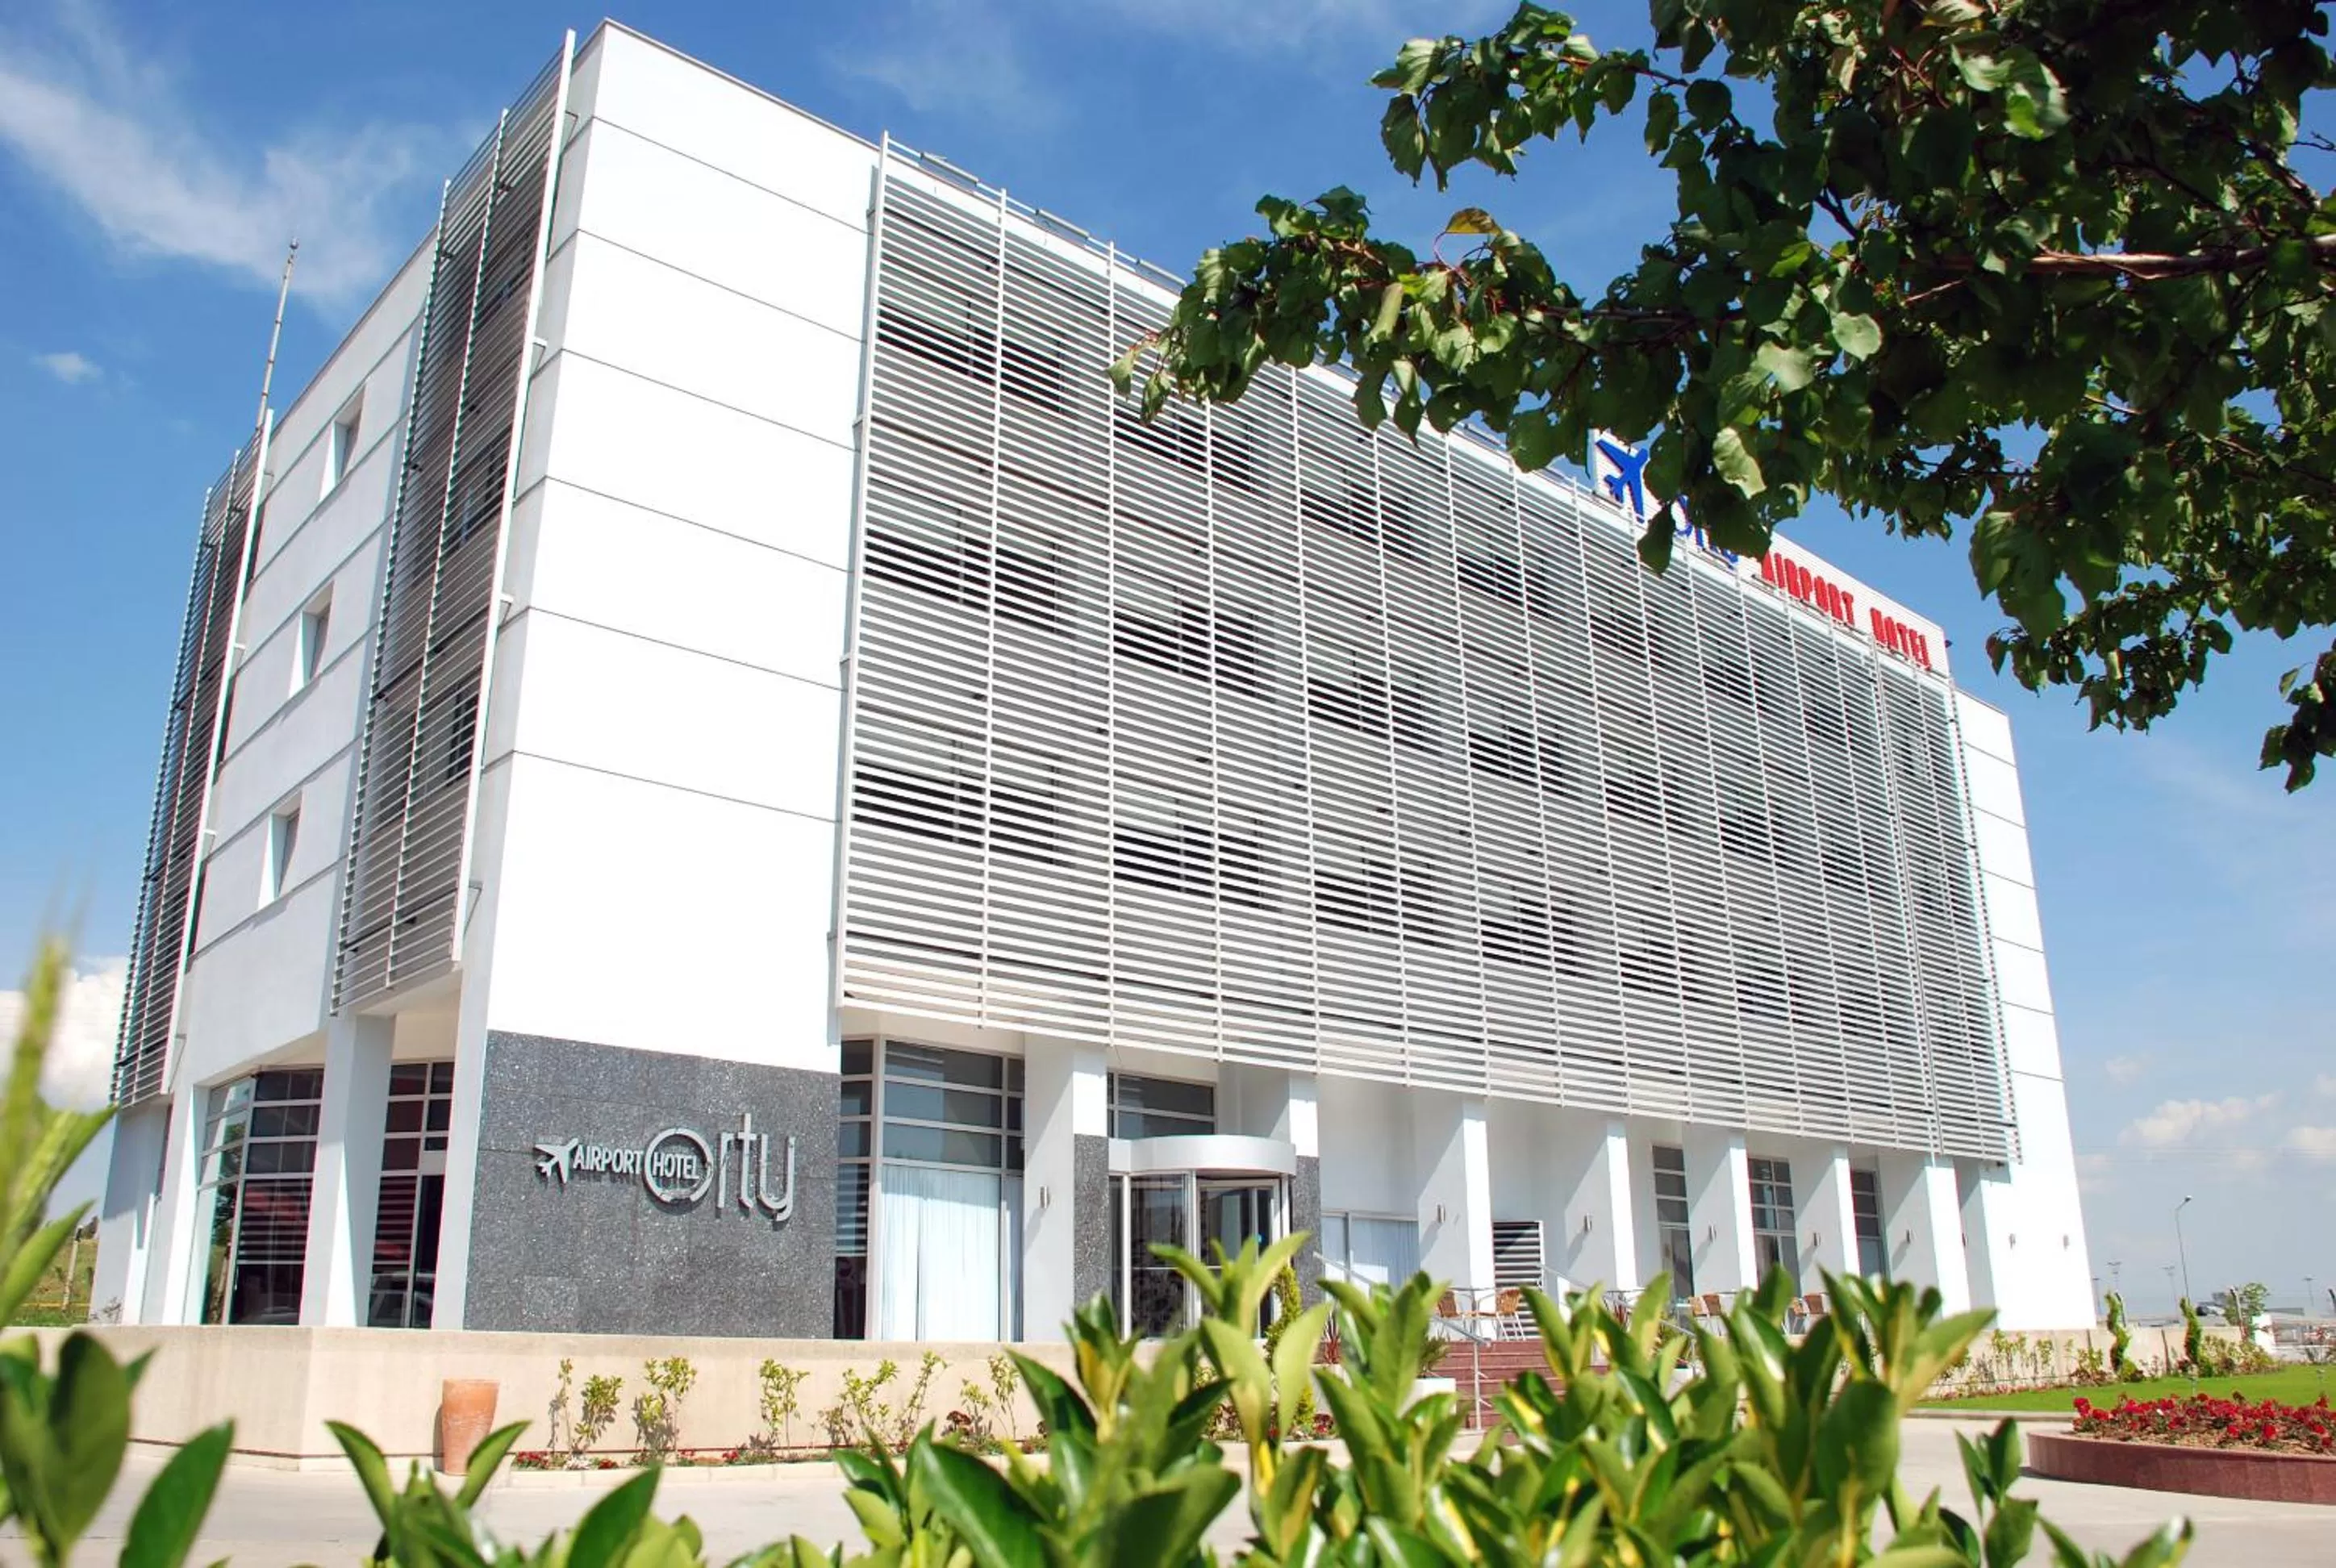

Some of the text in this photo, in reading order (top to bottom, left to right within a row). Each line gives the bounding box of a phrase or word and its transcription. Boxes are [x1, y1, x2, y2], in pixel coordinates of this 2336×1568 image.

[1761, 549, 1932, 671] AIRPORT HOTEL
[573, 1144, 700, 1179] AIRPORT HOTEL
